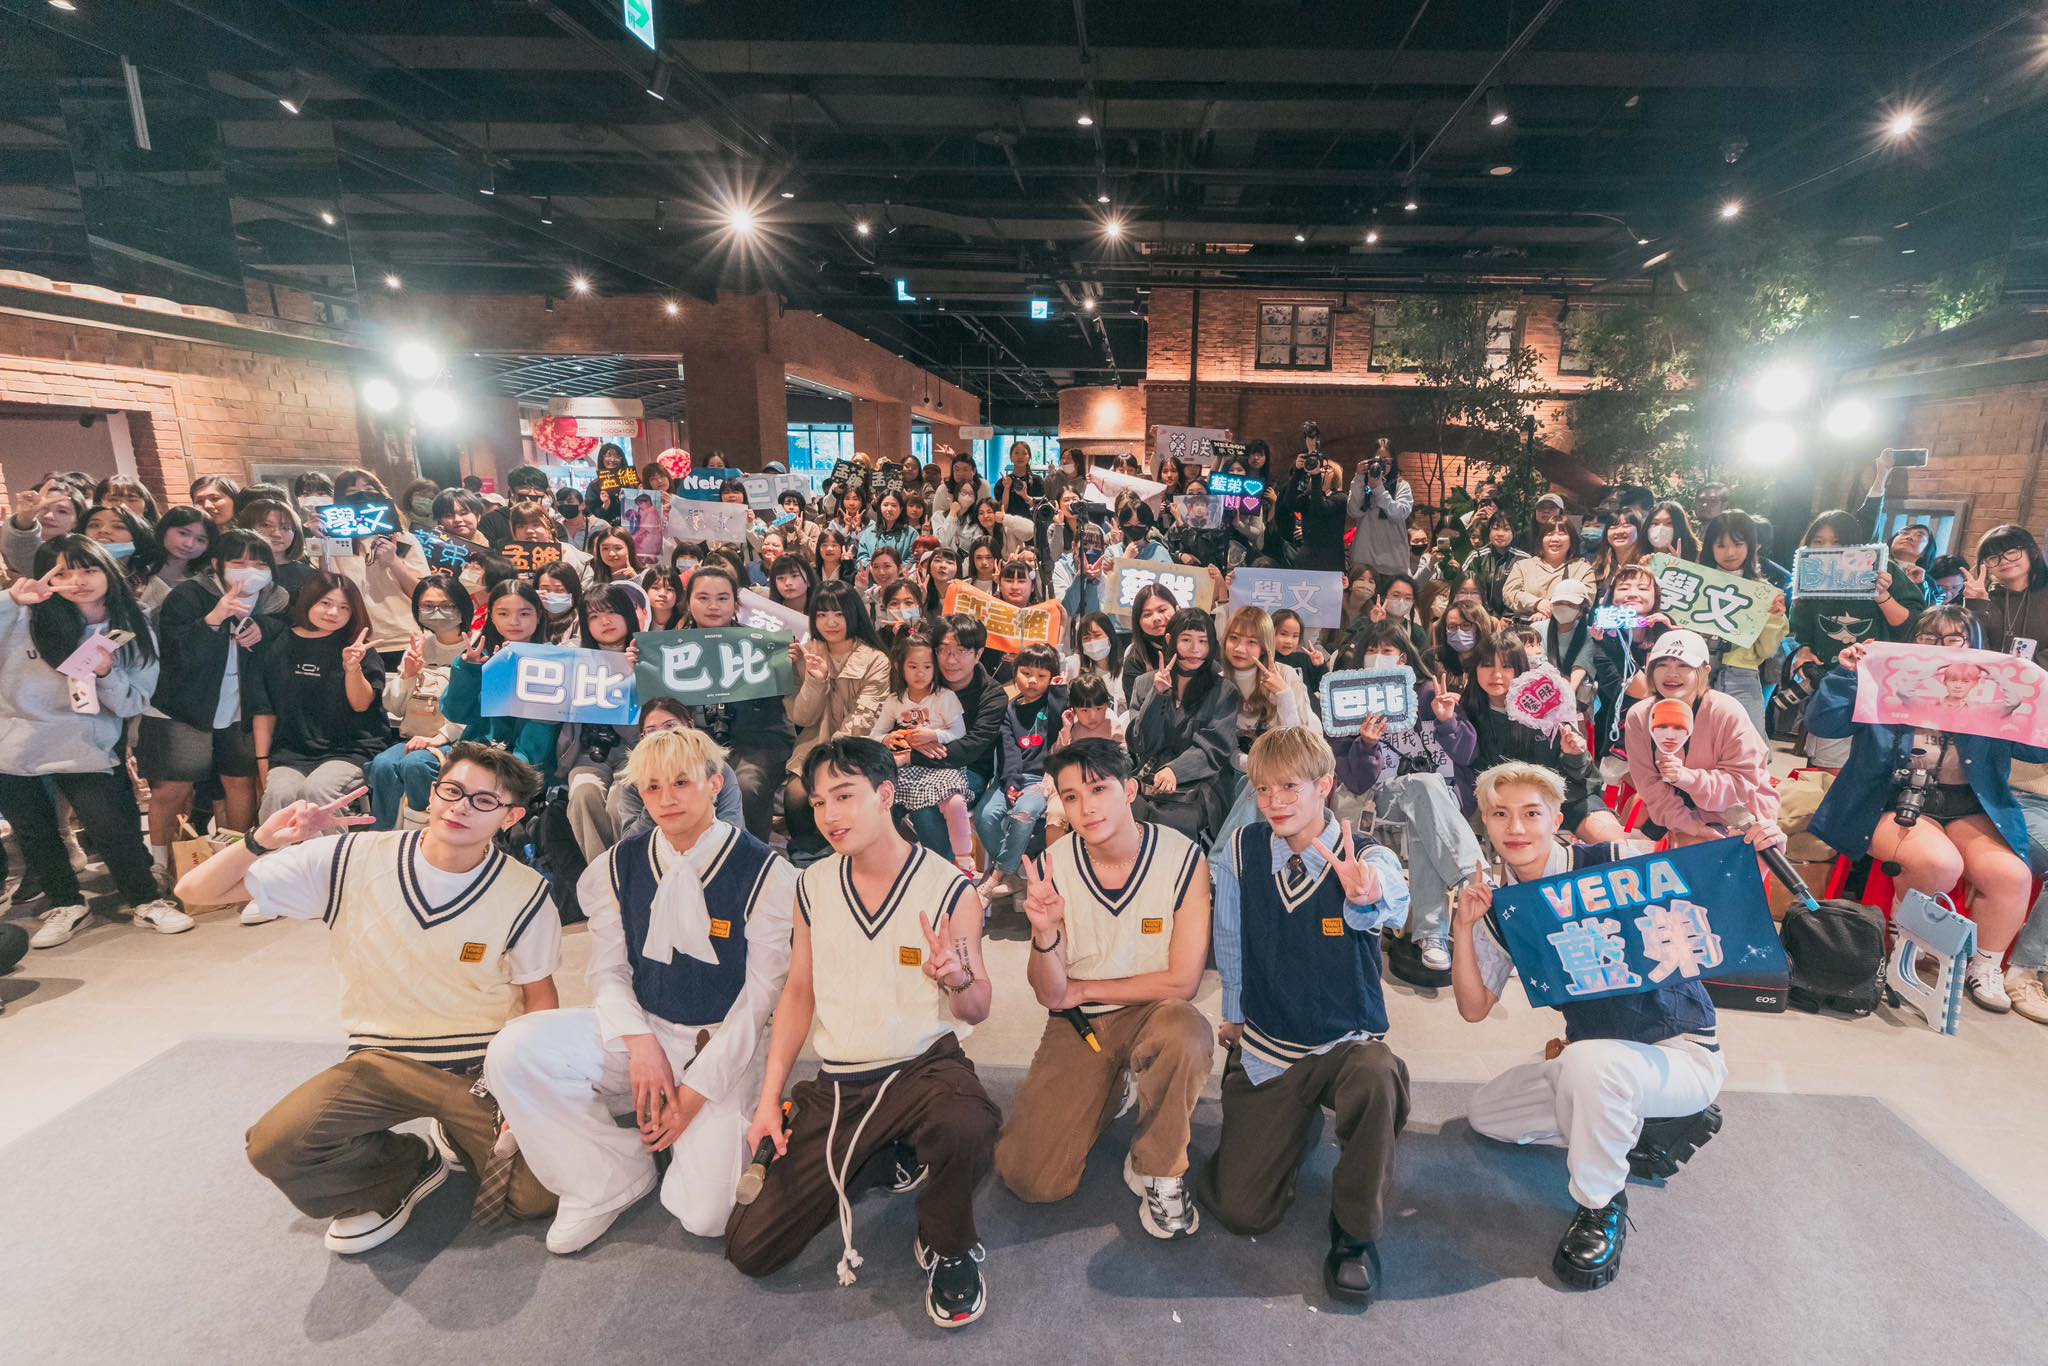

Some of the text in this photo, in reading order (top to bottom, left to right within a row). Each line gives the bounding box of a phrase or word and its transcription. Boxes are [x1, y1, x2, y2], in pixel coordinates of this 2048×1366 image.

[1209, 474, 1242, 494] 藍弟
[322, 503, 394, 536] 學文
[1251, 579, 1322, 614] 學文
[1659, 569, 1750, 635] 學文
[516, 656, 625, 709] 巴比
[659, 639, 772, 692] 巴比
[1332, 684, 1405, 718] 巴比
[1541, 859, 1690, 920] VERA
[1546, 898, 1725, 996] 藍弟
[1755, 995, 1777, 1004] EOS
